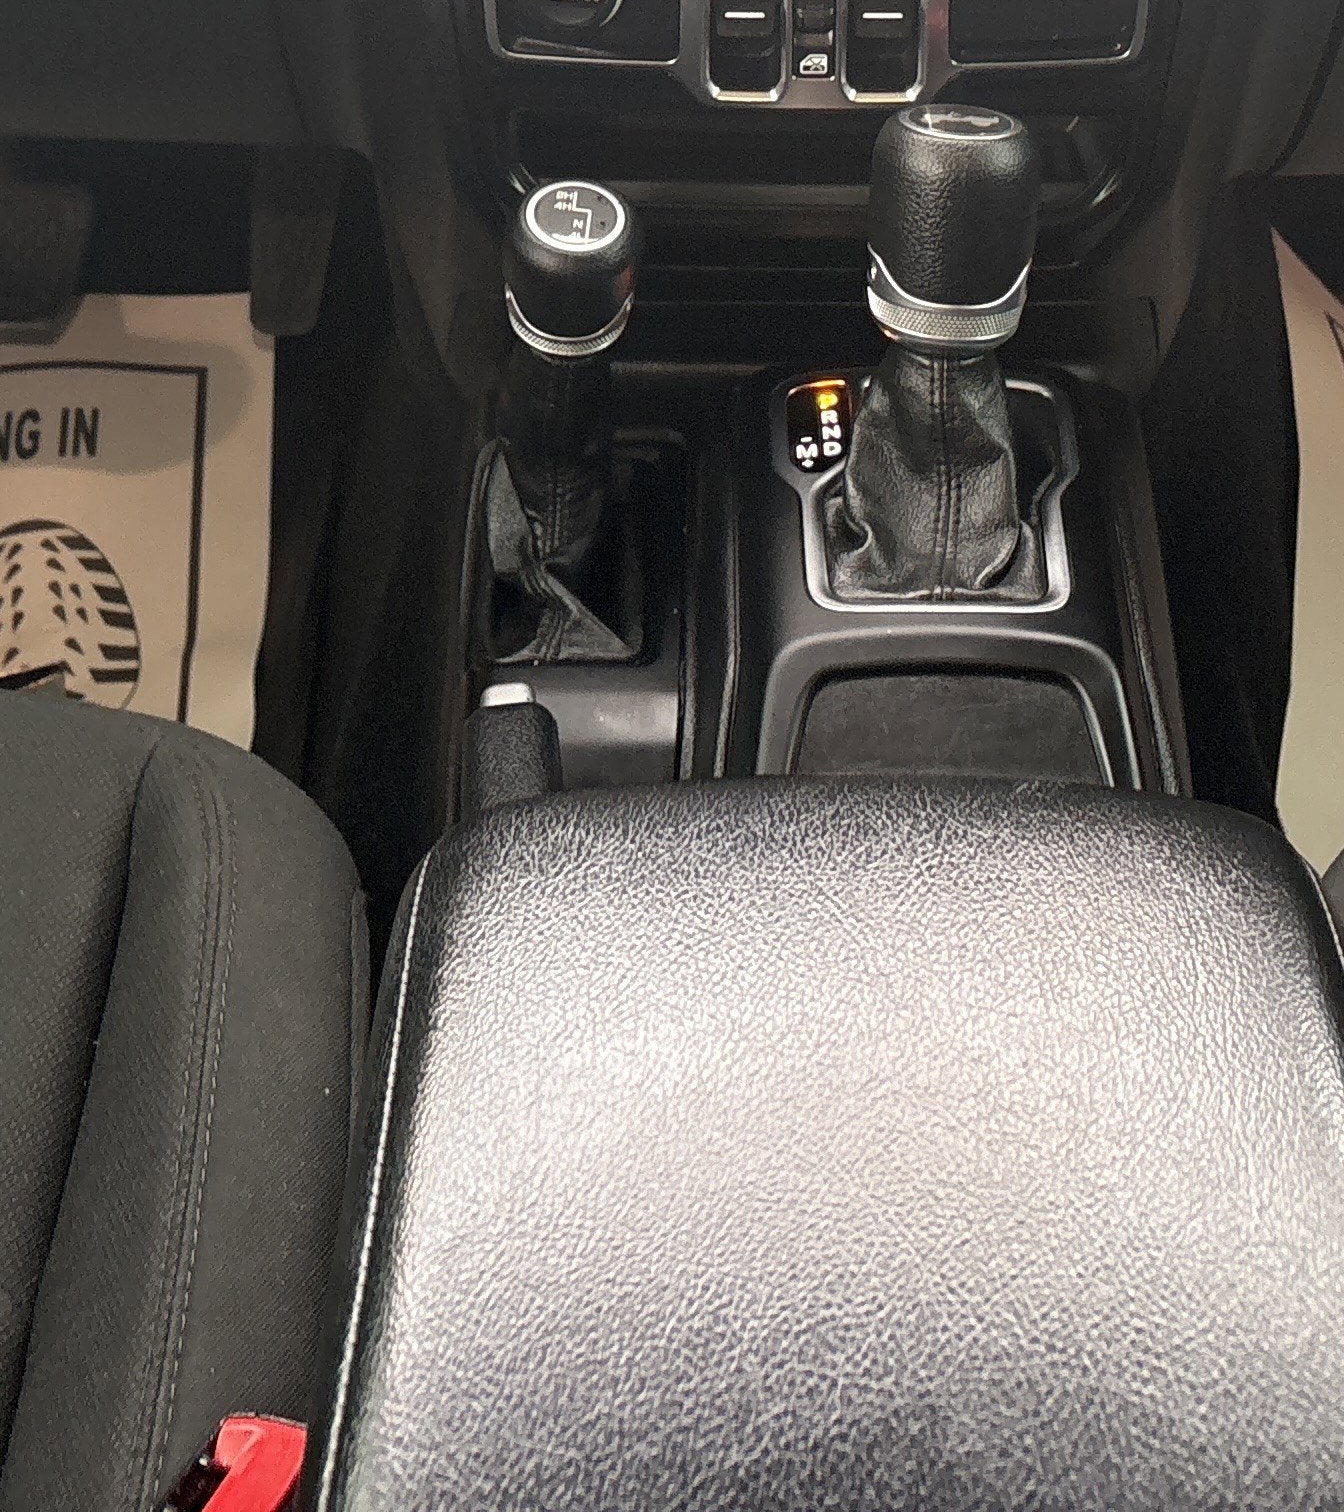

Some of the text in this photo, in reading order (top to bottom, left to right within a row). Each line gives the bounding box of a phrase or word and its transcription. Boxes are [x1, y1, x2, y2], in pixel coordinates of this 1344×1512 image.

[553, 201, 572, 211] 4H
[572, 218, 584, 229] N
[818, 393, 838, 409] P
[821, 409, 838, 425] R
[57, 406, 101, 458] IN
[821, 424, 842, 440] N
[796, 443, 818, 459] M
[823, 441, 842, 457] D
